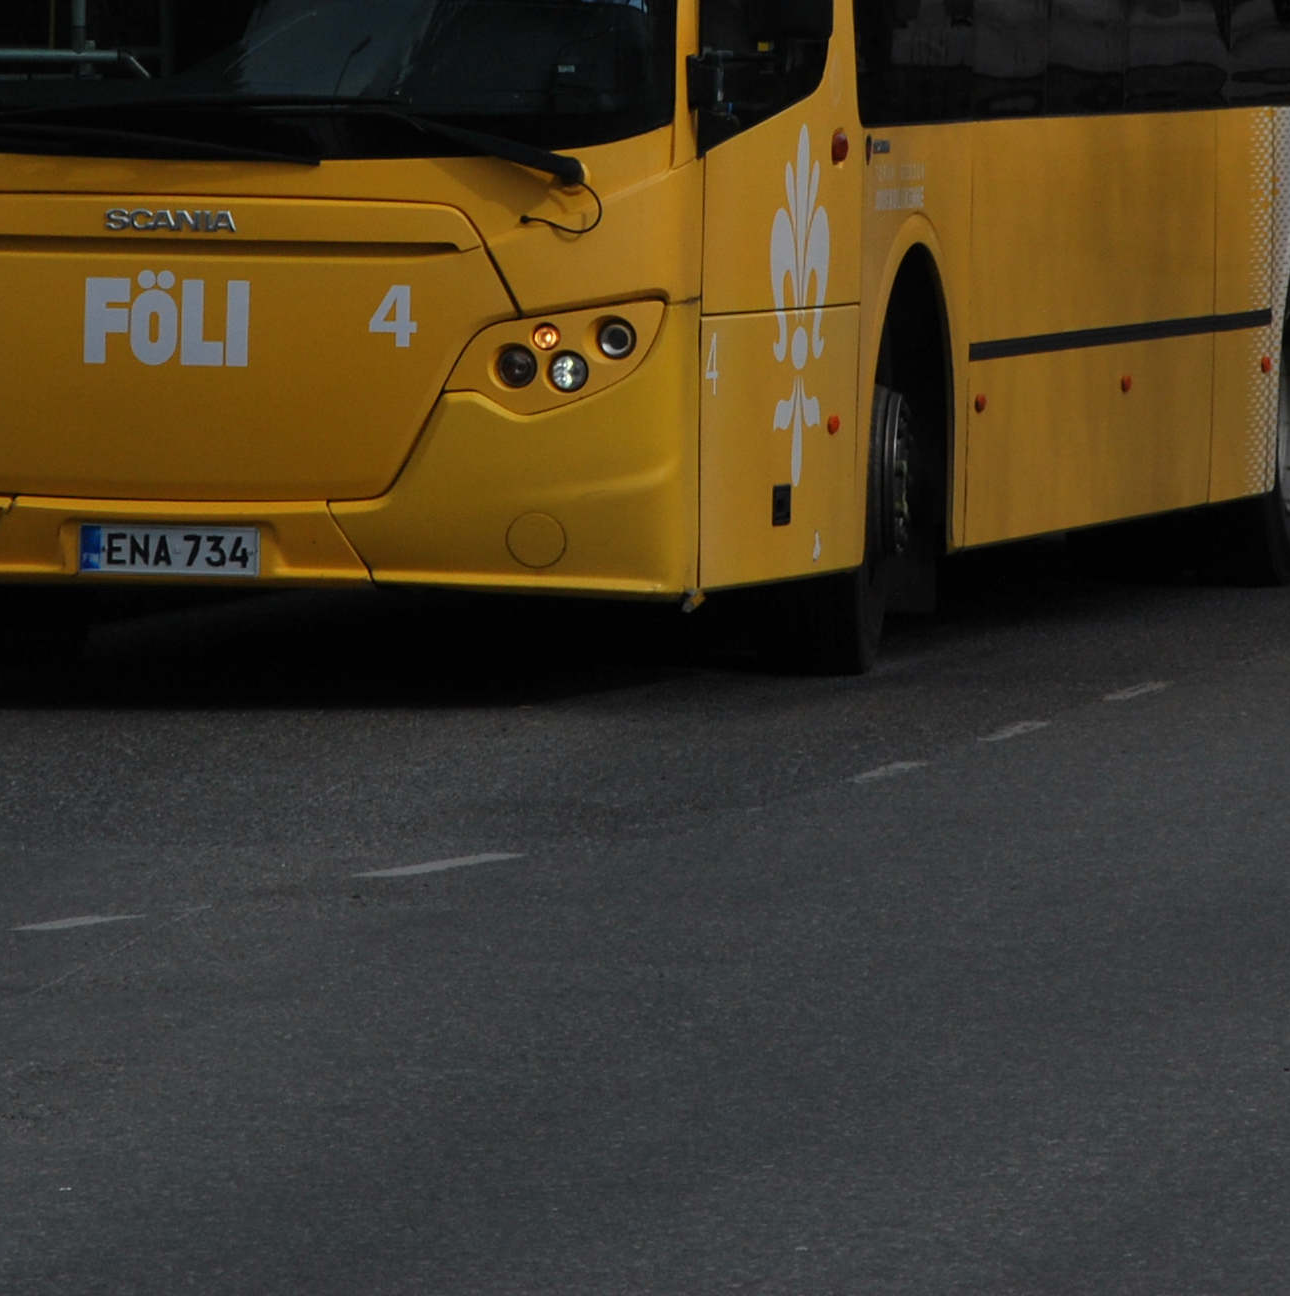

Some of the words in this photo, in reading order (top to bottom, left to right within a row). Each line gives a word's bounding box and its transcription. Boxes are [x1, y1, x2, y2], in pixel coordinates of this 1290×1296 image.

[105, 208, 237, 233] SCANIA
[83, 269, 251, 368] FÖLI
[368, 284, 418, 348] 4
[705, 331, 719, 396] 4
[106, 533, 172, 567] ENA
[183, 534, 249, 569] 734
